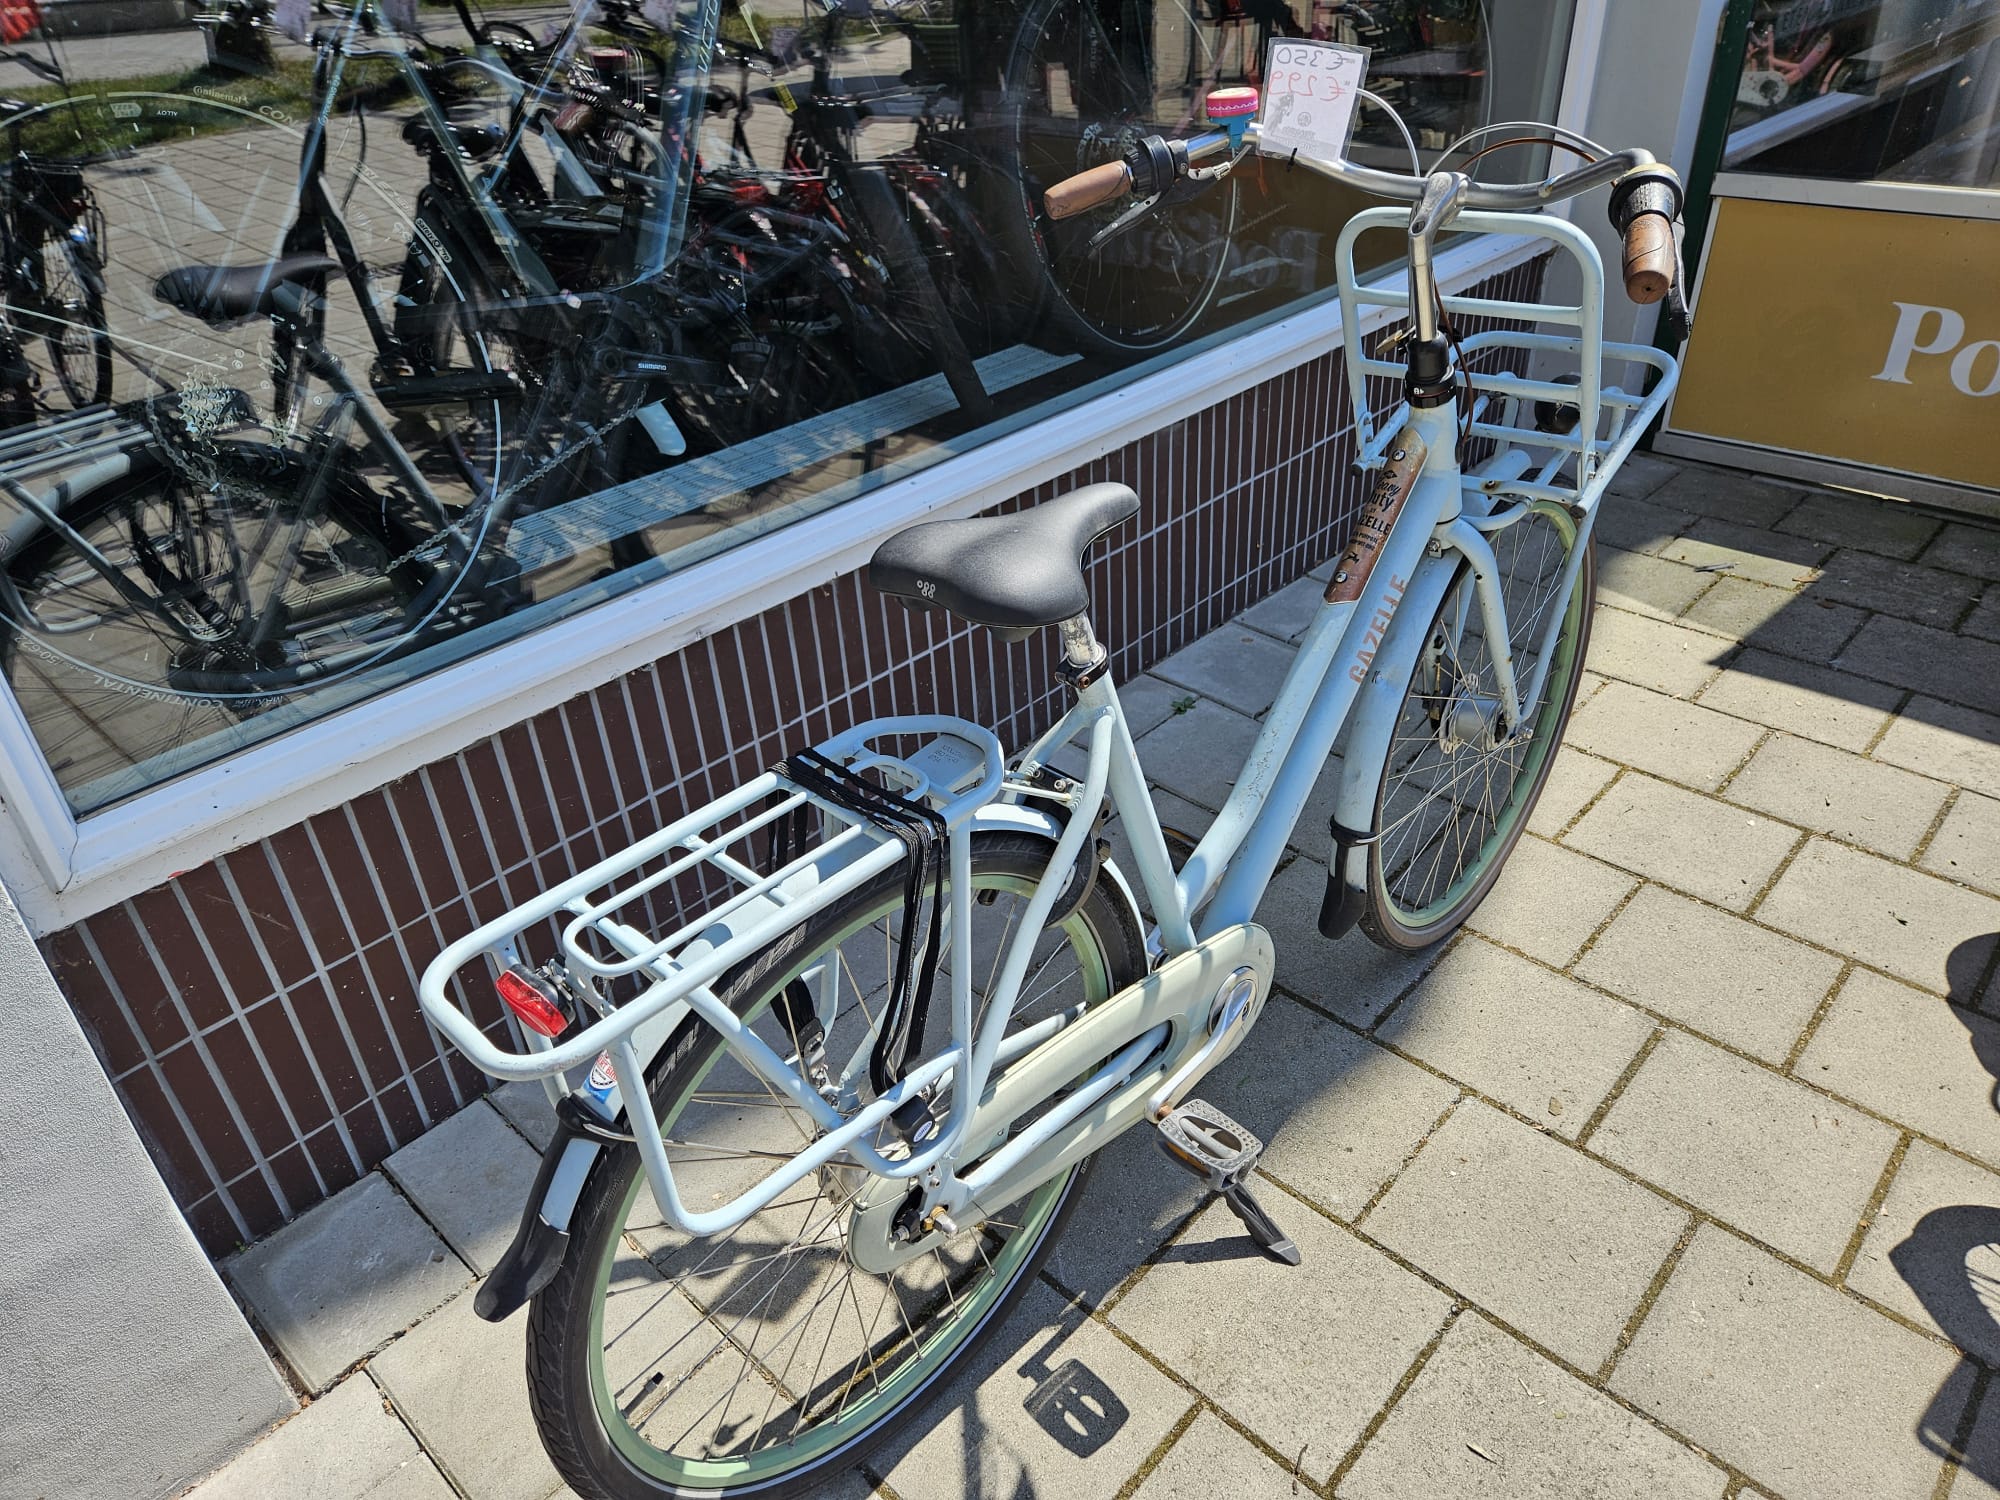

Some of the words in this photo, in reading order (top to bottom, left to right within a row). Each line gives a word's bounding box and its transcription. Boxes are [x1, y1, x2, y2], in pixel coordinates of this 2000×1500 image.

[192, 85, 244, 103] Continental
[1870, 301, 2000, 397] Po
[638, 363, 667, 371] SHIMANO
[1358, 514, 1392, 536] ZELLE
[1349, 573, 1407, 684] GAZELLE
[94, 674, 223, 709] CONTINENTAL
